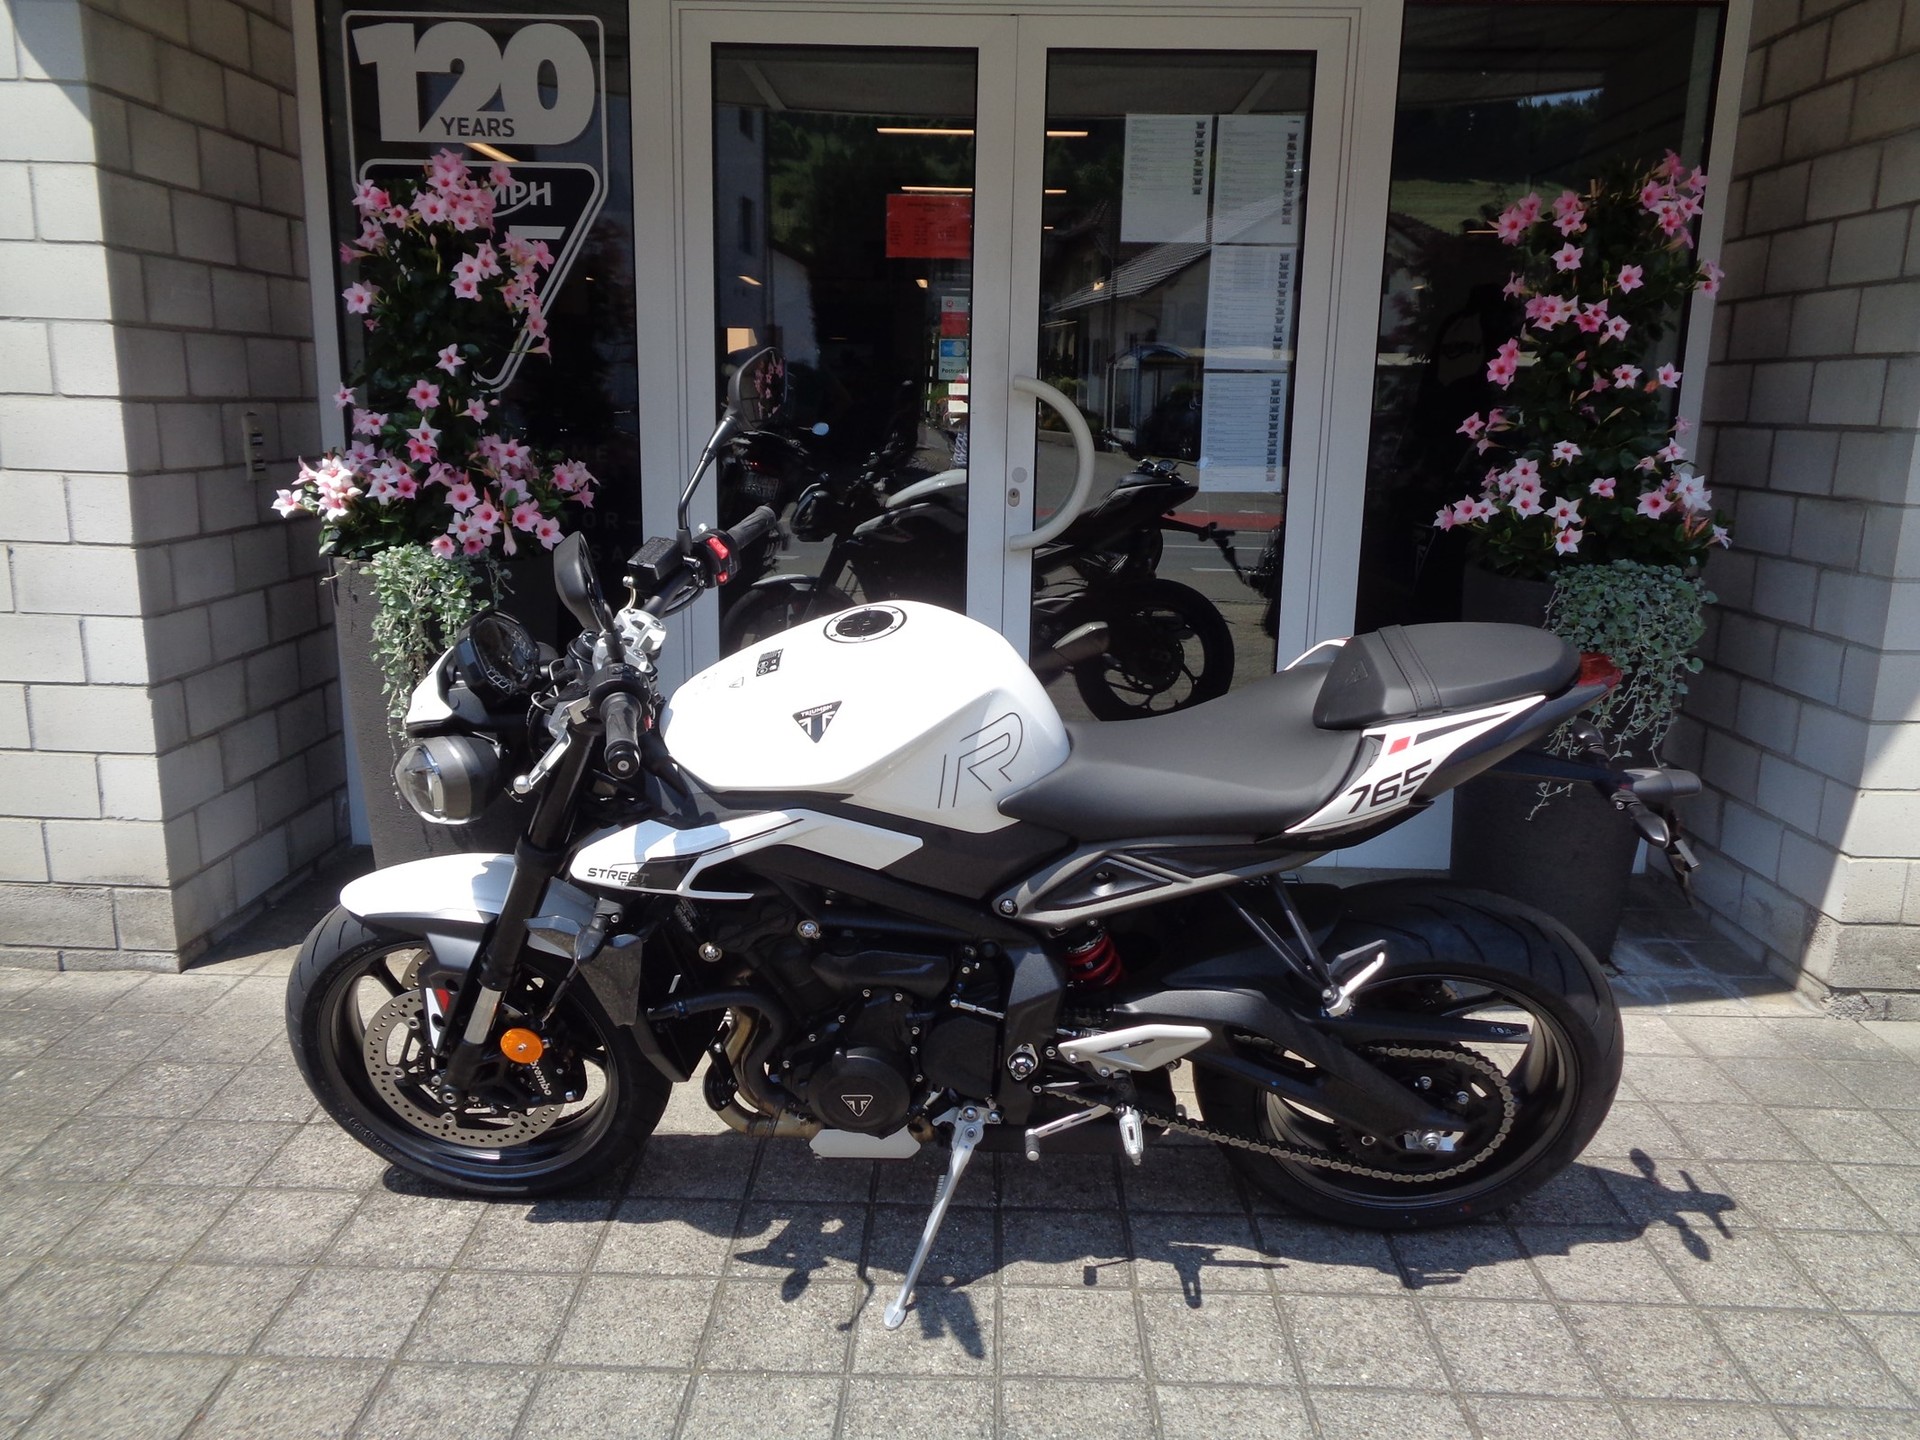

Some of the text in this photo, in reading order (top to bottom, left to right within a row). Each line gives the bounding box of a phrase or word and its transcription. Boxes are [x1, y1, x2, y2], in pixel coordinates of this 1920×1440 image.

[351, 21, 595, 145] 120
[440, 116, 515, 138] YEARS
[800, 704, 833, 717] TRIUMPH
[1348, 758, 1432, 815] 765
[587, 867, 650, 883] STREET
